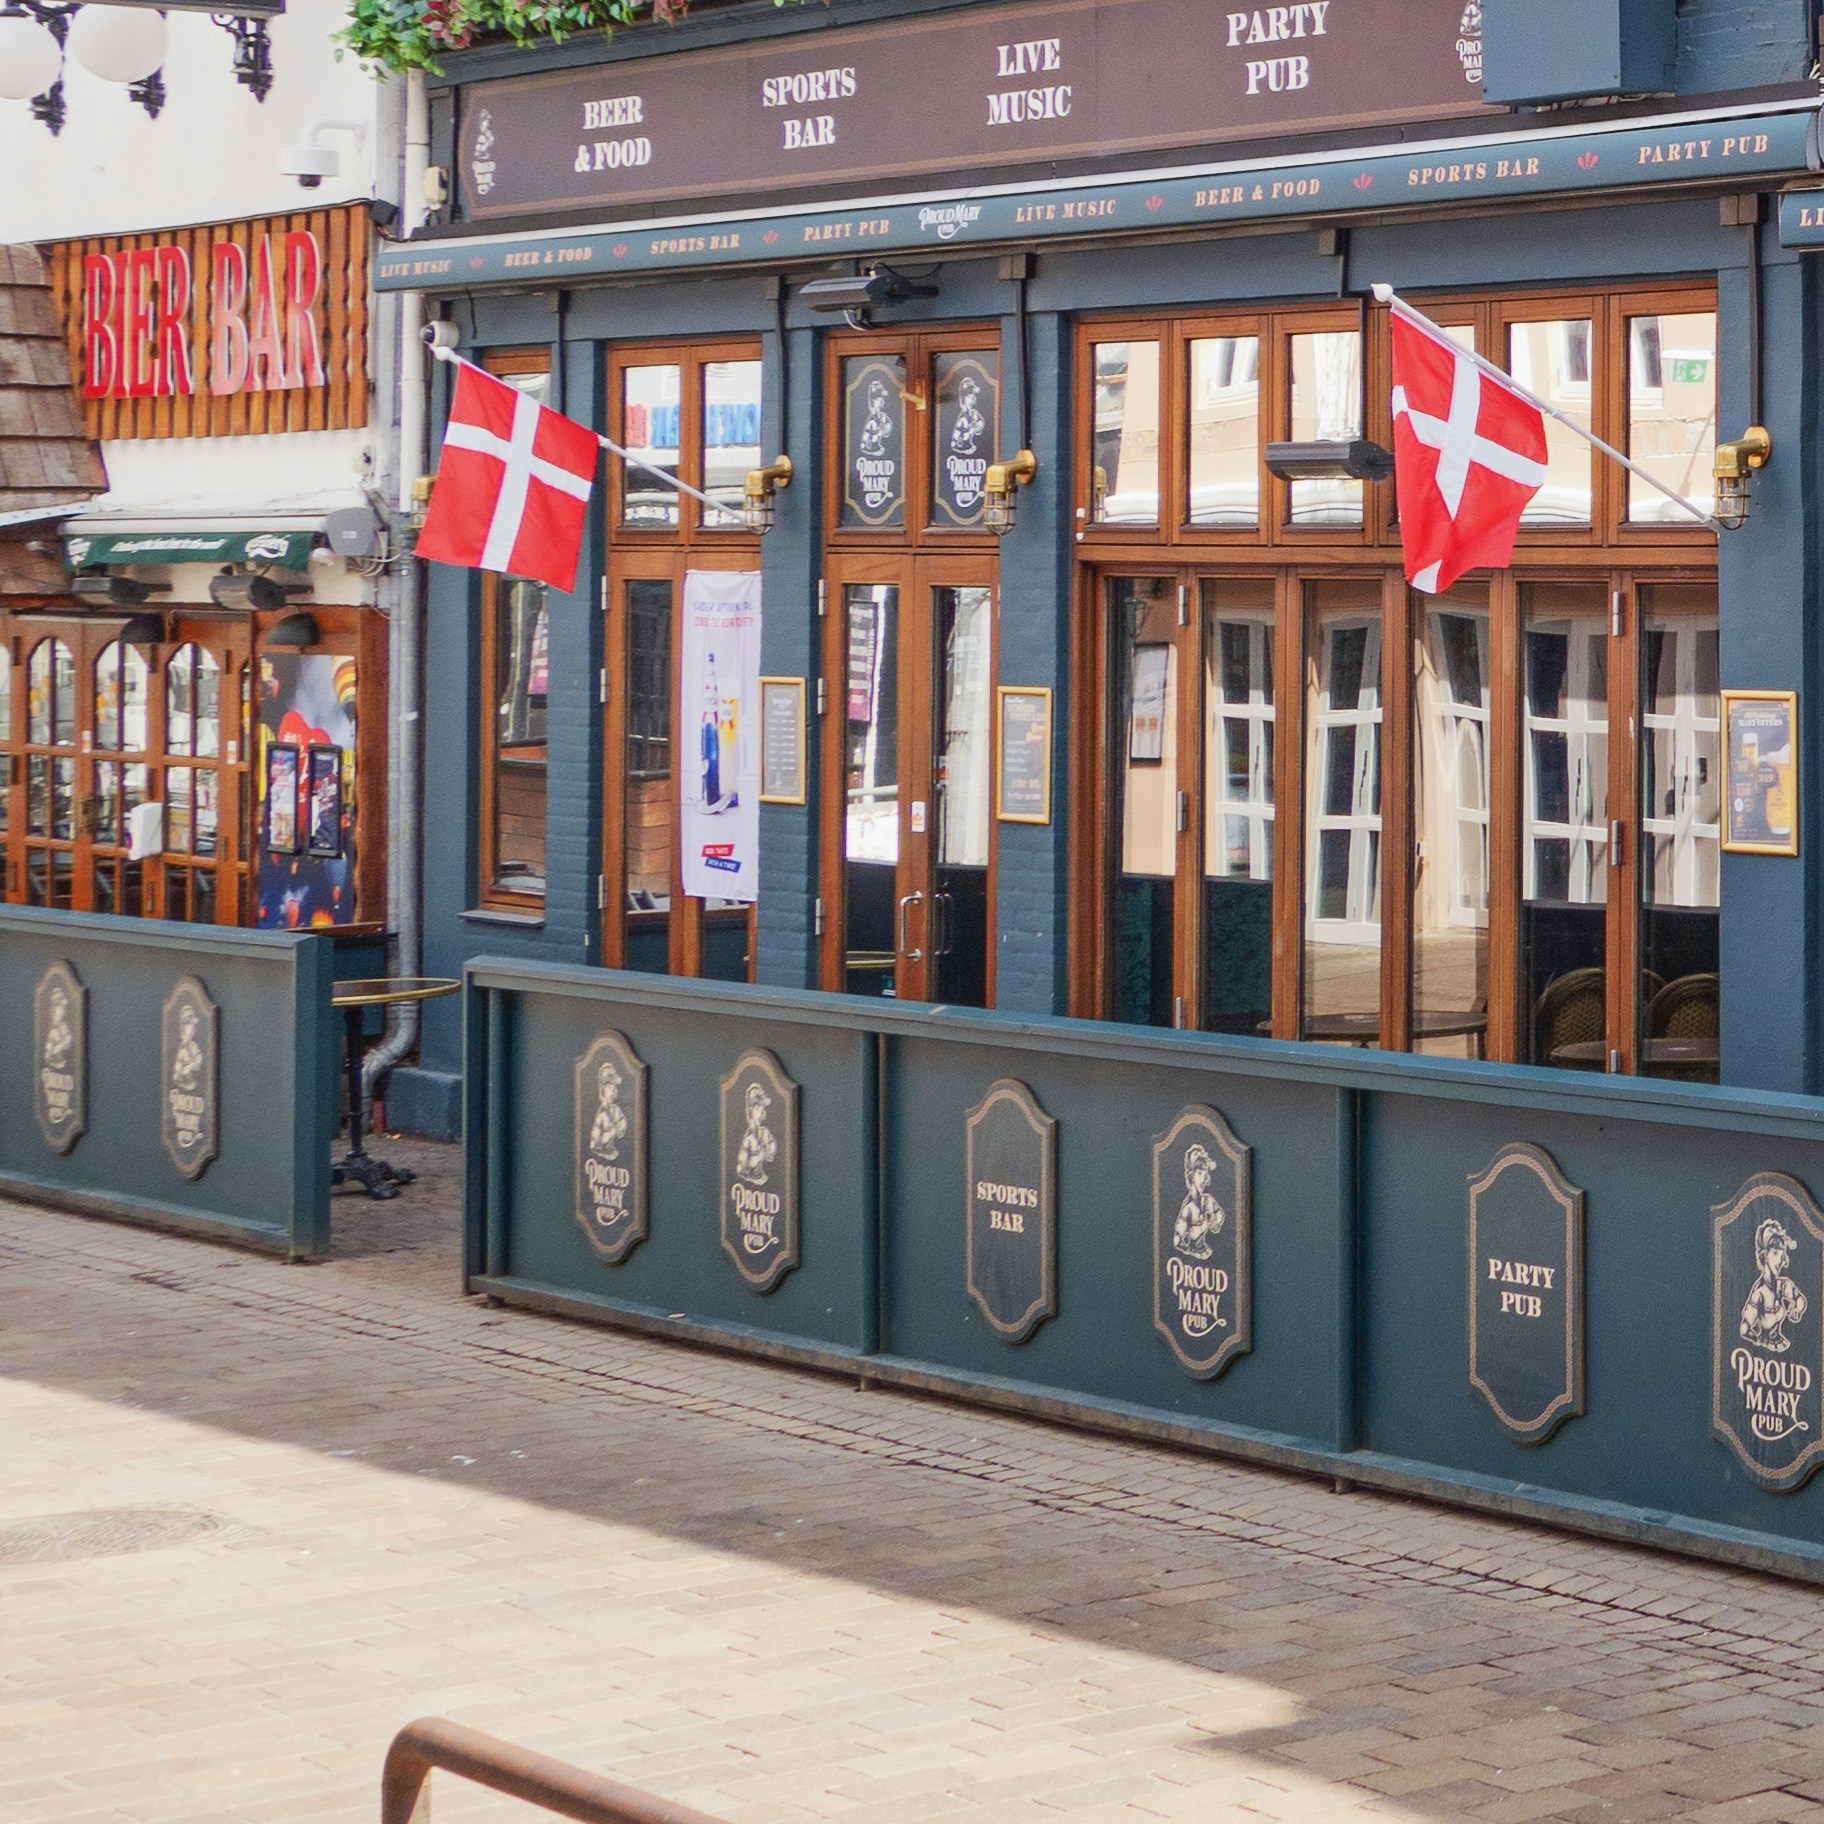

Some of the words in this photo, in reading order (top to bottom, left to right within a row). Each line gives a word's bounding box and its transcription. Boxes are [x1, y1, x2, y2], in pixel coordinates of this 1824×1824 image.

[1225, 0, 1330, 47] PARTY
[996, 38, 1061, 77] LIVE
[762, 67, 857, 108] SPORTS
[1245, 56, 1310, 96] PUB
[582, 95, 643, 130] BEER
[986, 85, 1073, 125] MUSIC
[783, 115, 836, 151] BAR
[1638, 139, 1712, 164] PARTY
[1722, 133, 1769, 155] PUB
[574, 144, 592, 174] &
[593, 137, 652, 171] FOOD
[1408, 162, 1486, 186] SPORTS
[1496, 157, 1540, 178] BAR
[1195, 186, 1243, 207] BEER
[1251, 184, 1263, 201] &
[1272, 178, 1321, 197] FOOD
[1015, 204, 1056, 224] LIVE
[1062, 199, 1117, 219] MUSIC
[650, 237, 704, 255] SPORTS
[709, 233, 740, 251] BAR
[803, 223, 853, 242] PARTY
[859, 219, 890, 238] PUB
[504, 251, 539, 267] BEER
[558, 246, 593, 262] FOOD
[83, 246, 195, 399] BIER
[211, 231, 325, 395] BAR
[856, 456, 895, 483] PROUD
[947, 455, 987, 482] PROUD
[585, 1158, 630, 1191] PROUD
[592, 1185, 625, 1209] MARY
[731, 1182, 780, 1216] PROUD
[976, 1181, 1038, 1208] SPORTS
[740, 1211, 775, 1237] MARY
[990, 1210, 1025, 1233] BAR
[1166, 1256, 1229, 1295] PROUD
[1488, 1257, 1556, 1289] PARTY
[1178, 1288, 1221, 1320] MARY
[1500, 1290, 1542, 1318] PUB
[1731, 1347, 1811, 1393] PROUD
[1746, 1386, 1802, 1422] MARY
